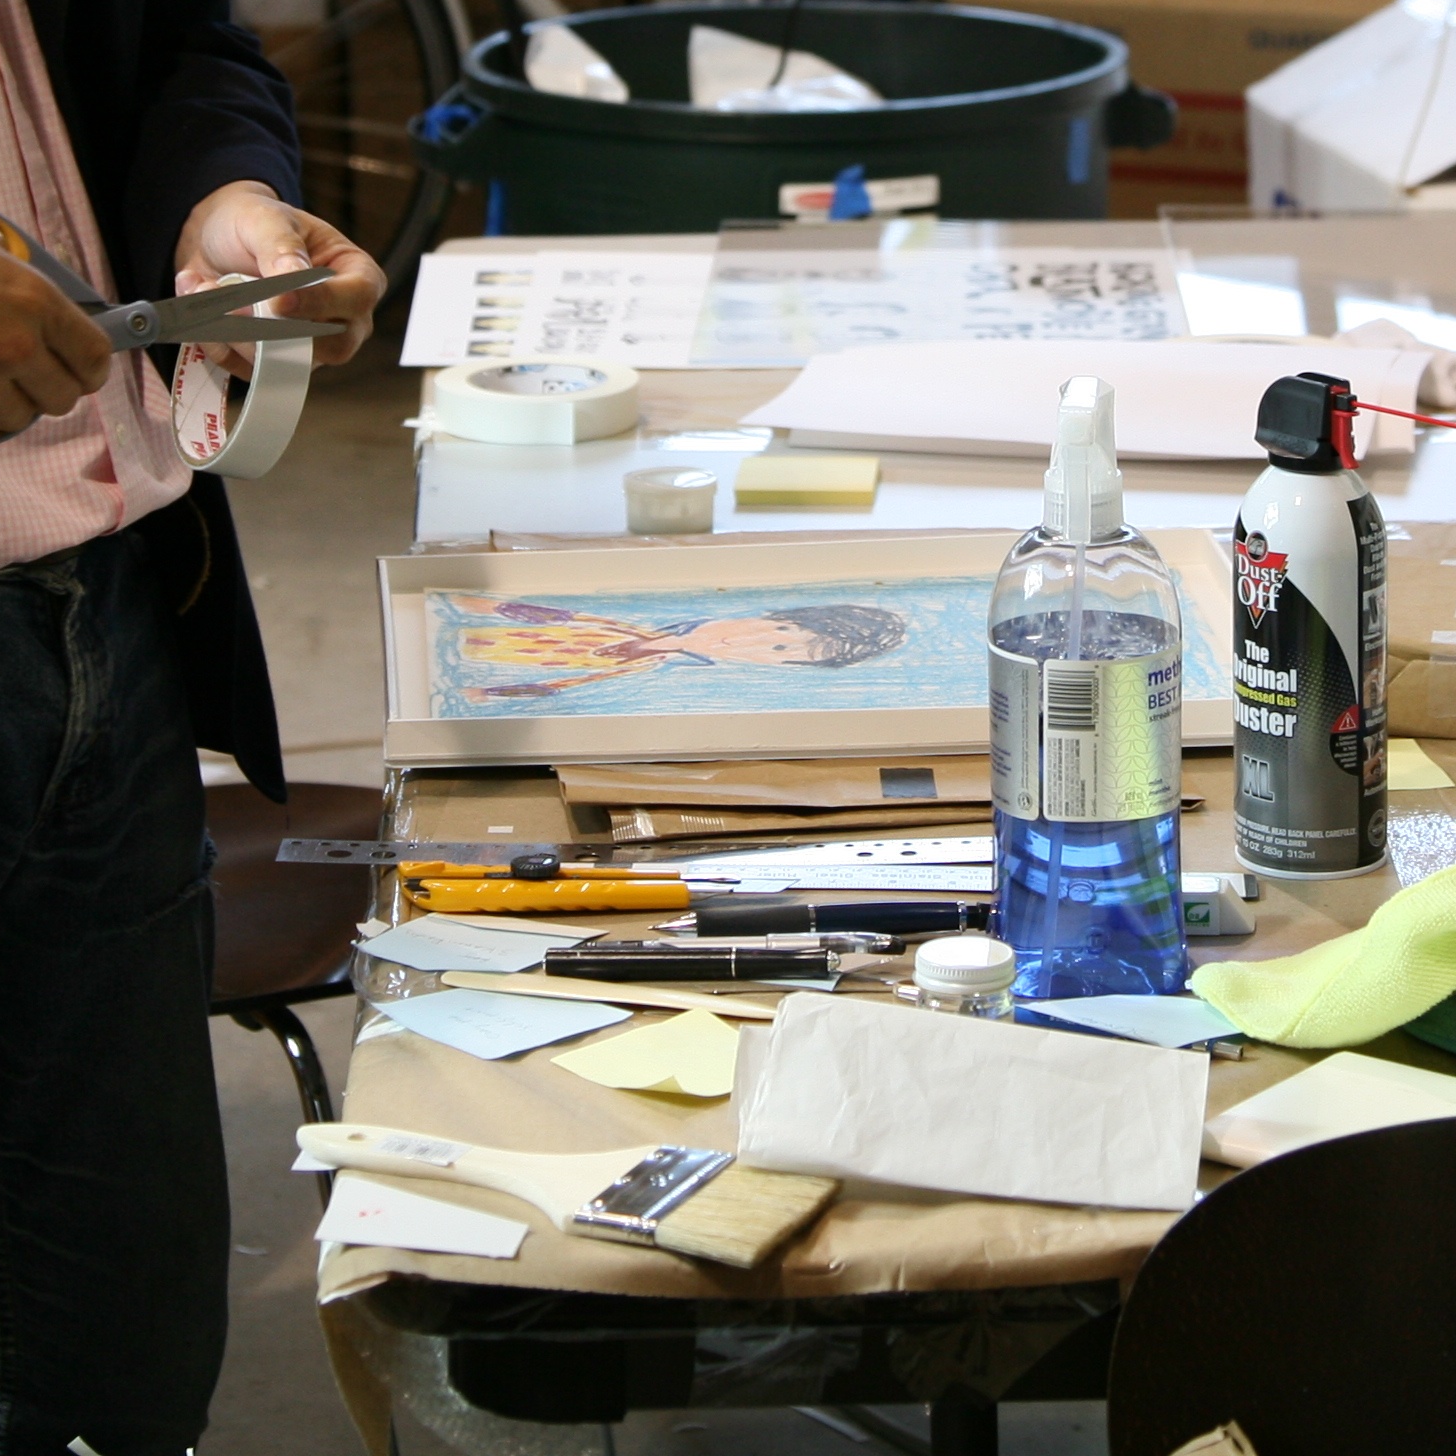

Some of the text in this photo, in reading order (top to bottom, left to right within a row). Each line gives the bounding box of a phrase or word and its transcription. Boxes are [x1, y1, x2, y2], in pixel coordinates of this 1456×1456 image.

[1237, 552, 1282, 584] Dust-
[1237, 576, 1282, 612] Off
[1244, 639, 1270, 664] The
[1148, 687, 1177, 710] BEST
[1277, 695, 1298, 708] Gas
[1242, 754, 1274, 802] XL
[1275, 837, 1307, 847] CHILDREN
[1288, 829, 1304, 838] BACK
[1305, 829, 1324, 838] PANEL
[1249, 840, 1260, 851] OZ
[1263, 845, 1283, 858] 283g
[1287, 849, 1316, 859] 312ml
